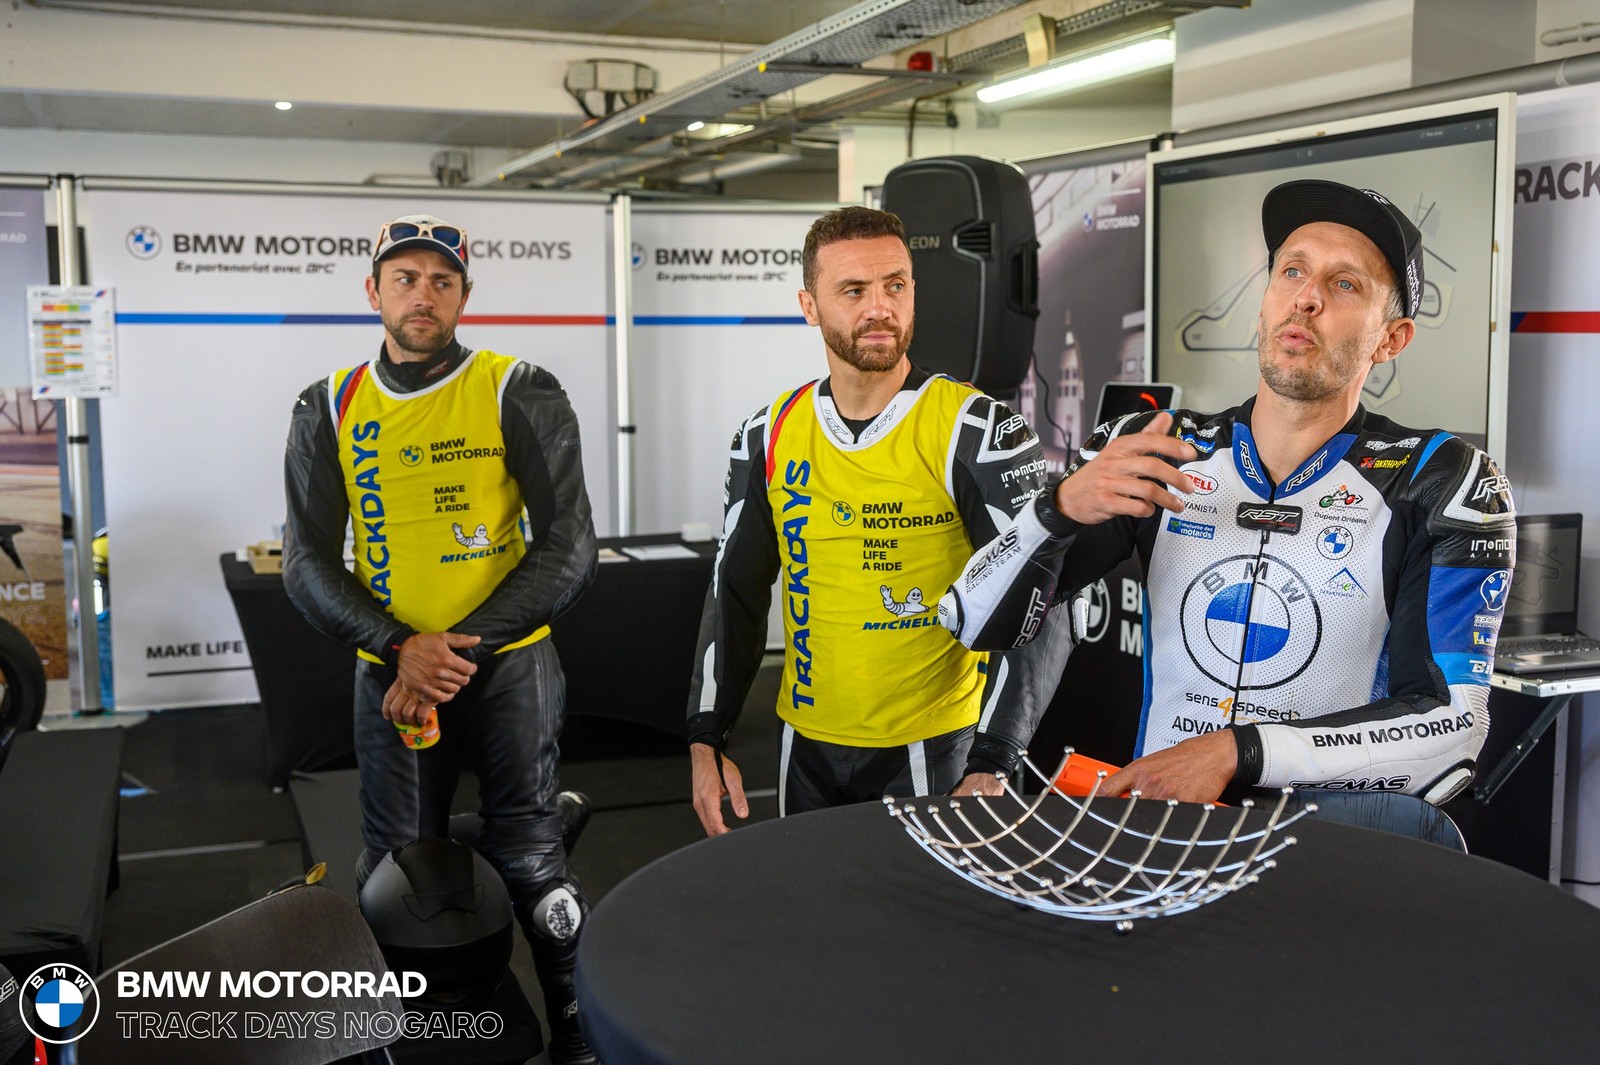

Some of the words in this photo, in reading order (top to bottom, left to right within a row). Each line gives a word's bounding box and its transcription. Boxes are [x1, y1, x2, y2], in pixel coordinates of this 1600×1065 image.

[1514, 160, 1600, 204] RACK
[173, 235, 244, 253] BMW
[256, 237, 372, 256] MOTORR
[510, 240, 571, 259] DAYS
[909, 236, 940, 249] EON
[655, 250, 712, 266] BMW
[721, 250, 804, 266] MOTOR
[176, 262, 192, 272] En
[195, 262, 269, 274] partenariat
[272, 265, 301, 274] avec
[864, 400, 897, 440] RST
[430, 438, 466, 452] BMW
[431, 447, 505, 464] MOTORRAD
[1240, 440, 1264, 484] RST
[1284, 449, 1328, 492] RST
[434, 484, 466, 495] MAKE
[1471, 475, 1513, 503] RS
[435, 495, 457, 504] LIFE
[445, 503, 470, 512] RIDE
[862, 502, 903, 514] BMW
[352, 420, 392, 609] ACKDAYS
[862, 511, 955, 530] MOTORRAD
[1238, 508, 1300, 522] RST
[1180, 528, 1213, 539] motards
[1323, 527, 1351, 538] BMW
[863, 540, 898, 549] MAKE
[440, 545, 507, 563] MICHELIN
[863, 551, 887, 560] LIFE
[862, 563, 871, 571] A
[873, 562, 903, 572] RIDE
[966, 567, 994, 595] RACING
[996, 545, 1022, 568] TEAM
[782, 459, 814, 711] TRACKDAYS
[1201, 561, 1306, 604] BMW
[862, 616, 943, 630] MICHELI
[1011, 586, 1047, 649] RST
[146, 643, 202, 659] MAKE
[206, 640, 243, 656] LIFE
[1312, 733, 1362, 747] BMW
[1370, 711, 1474, 744] MOTORRAD
